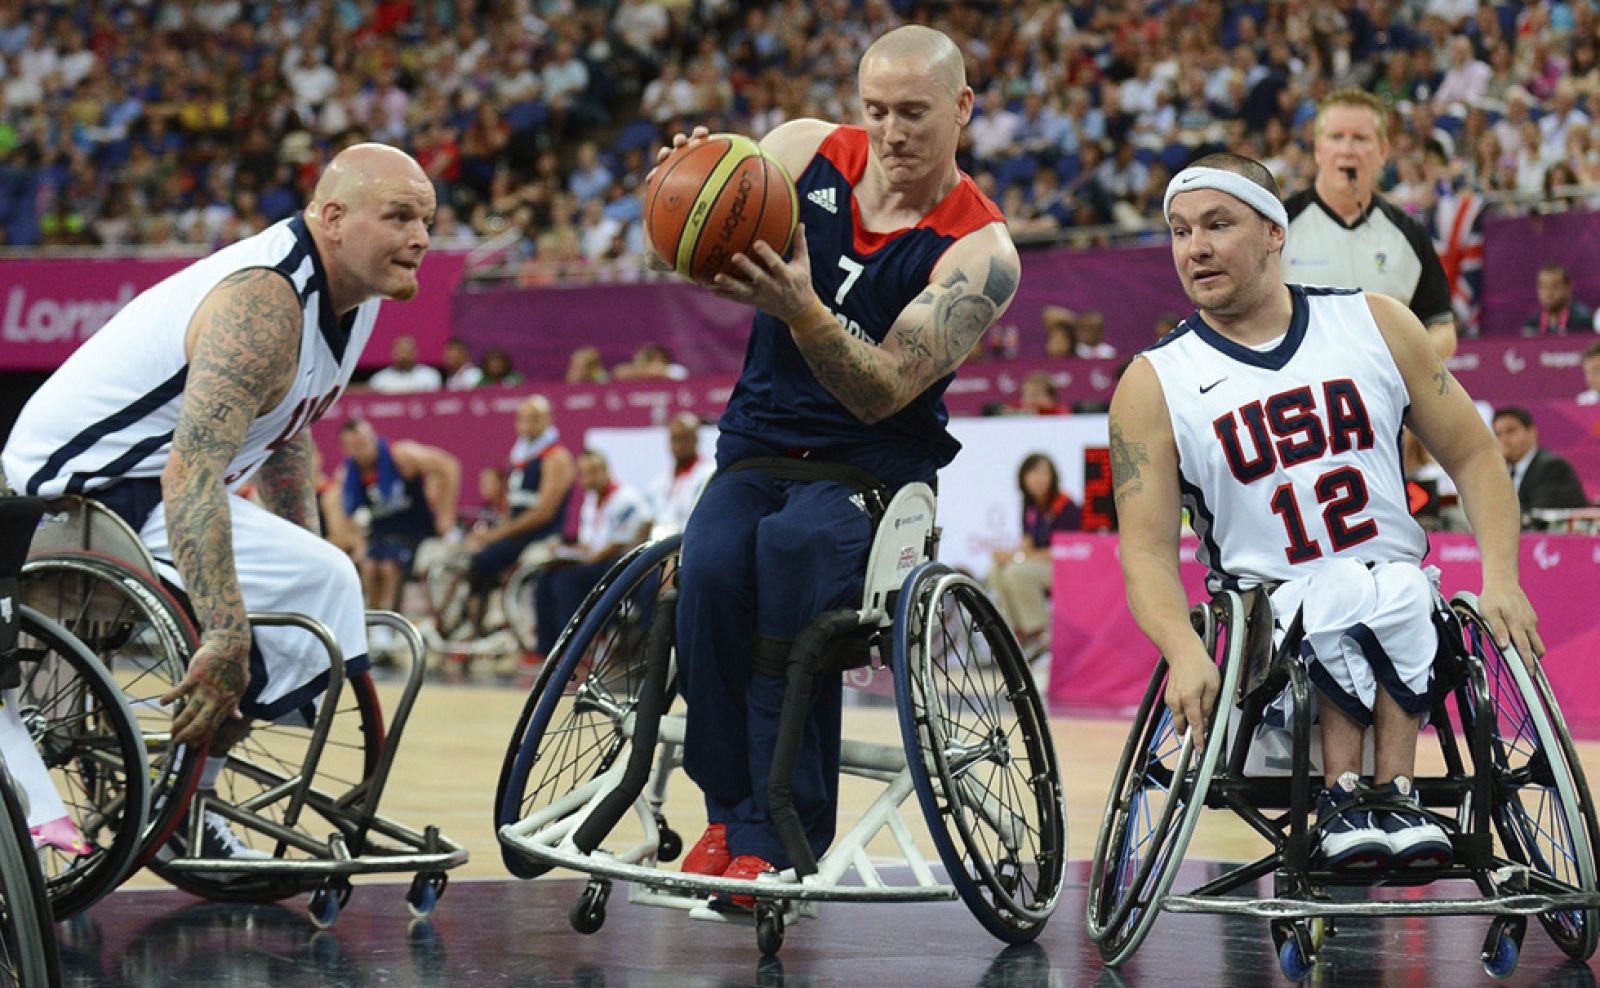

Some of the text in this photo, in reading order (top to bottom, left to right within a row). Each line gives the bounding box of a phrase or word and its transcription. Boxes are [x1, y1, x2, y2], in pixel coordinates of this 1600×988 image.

[834, 254, 865, 307] 7
[1213, 378, 1375, 485] USA
[1270, 465, 1379, 565] 12
